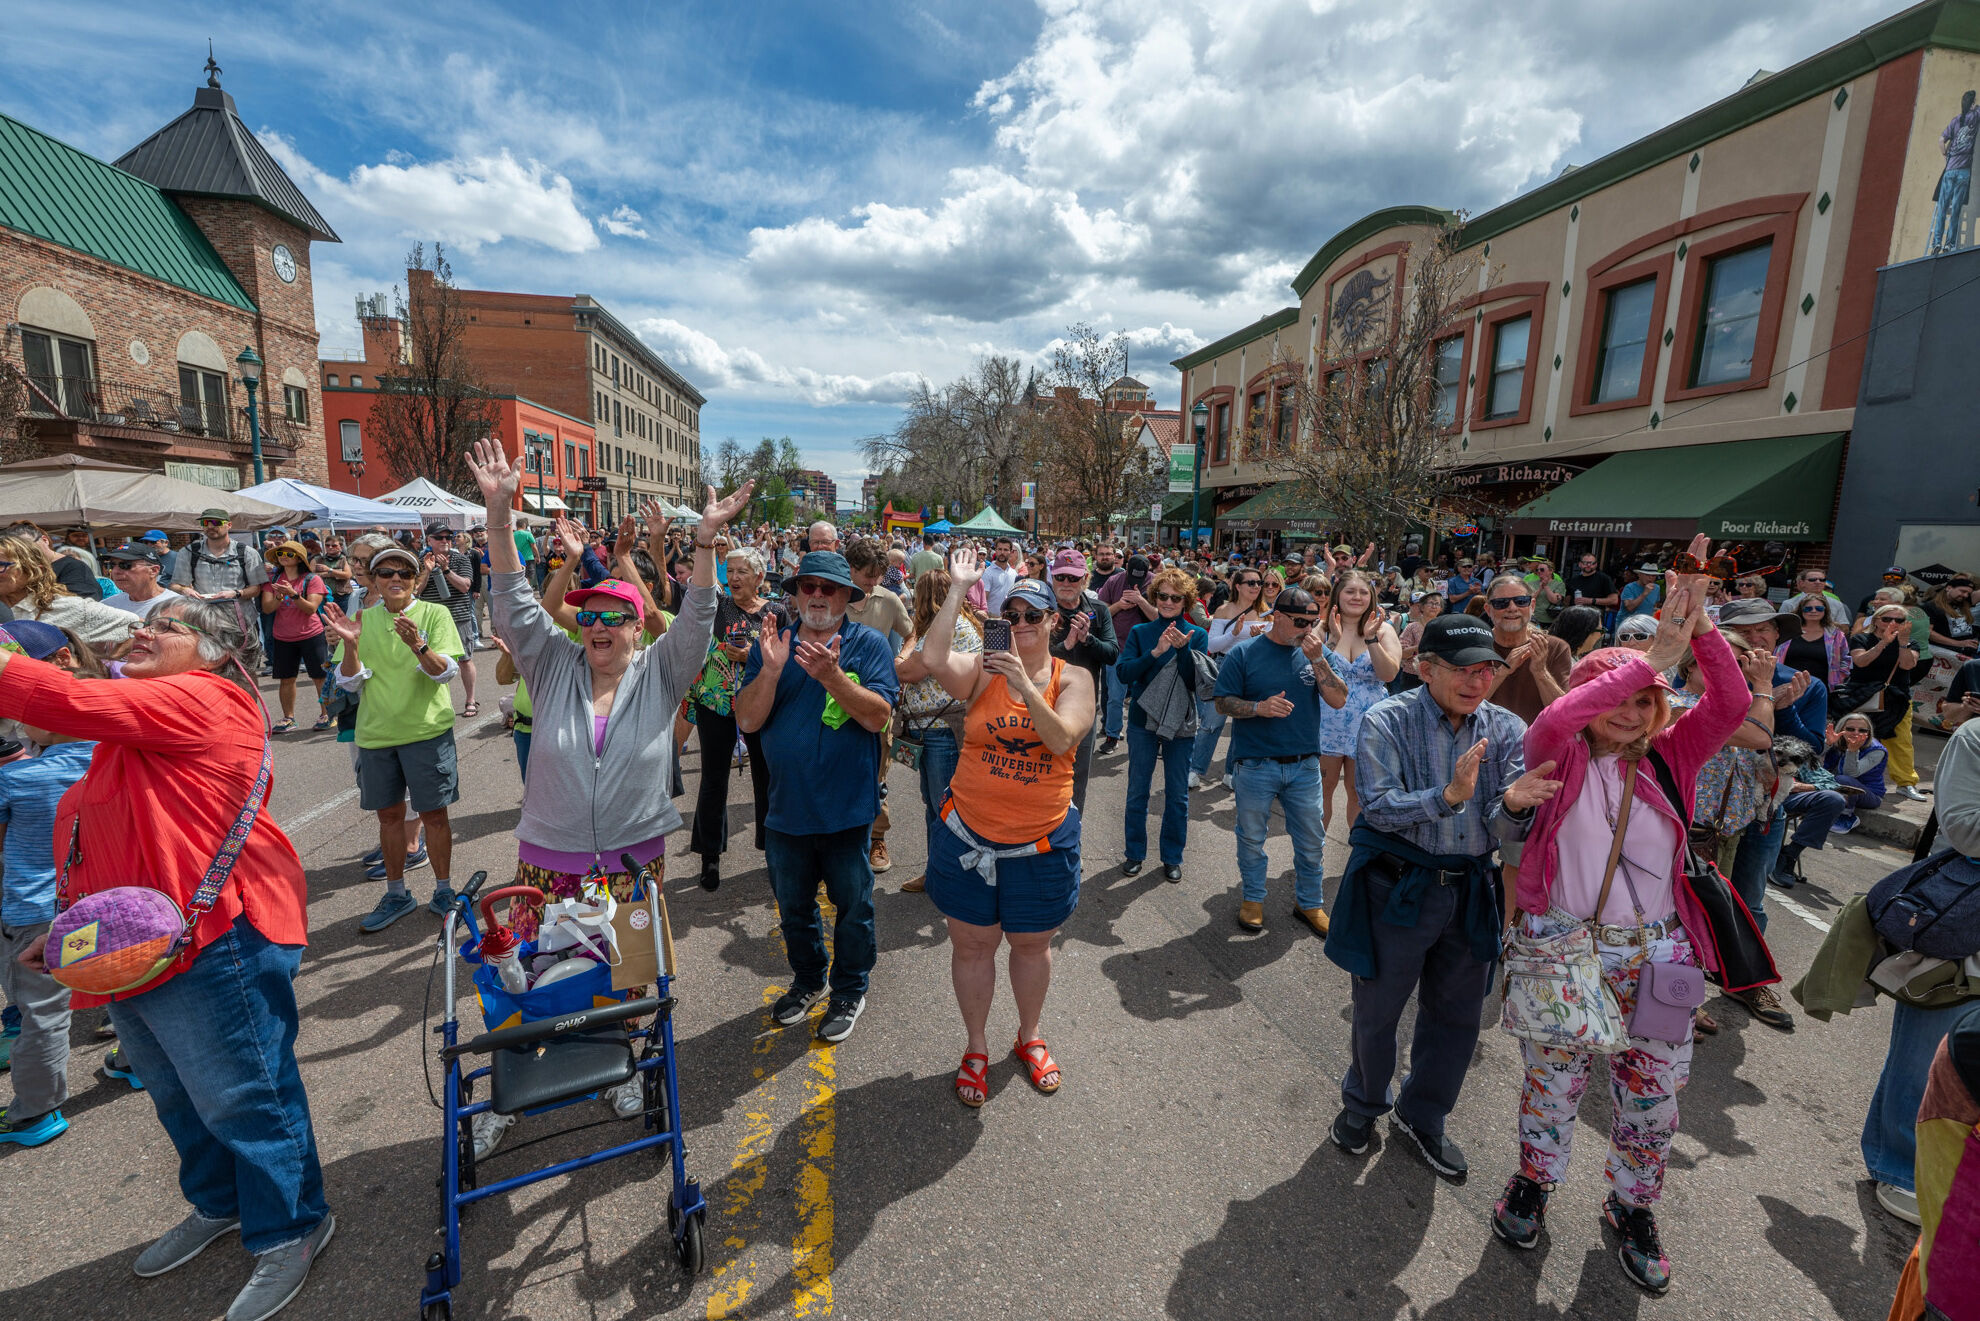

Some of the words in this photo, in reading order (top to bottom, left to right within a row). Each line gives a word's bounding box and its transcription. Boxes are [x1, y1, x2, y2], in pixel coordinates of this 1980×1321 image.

[1498, 465, 1573, 483] Richard's
[395, 496, 437, 507] TOSC
[421, 516, 450, 526] OALITION
[1290, 520, 1316, 529] Toystore
[1549, 519, 1633, 533] Restaurant
[1721, 520, 1750, 533] Poor
[1753, 521, 1810, 535] Richard's
[1453, 526, 1478, 535] OEN
[1920, 571, 1953, 580] TONY'S
[985, 715, 1036, 735] AUBU
[981, 751, 1053, 775] UNIVERSITY
[990, 766, 1010, 780] War
